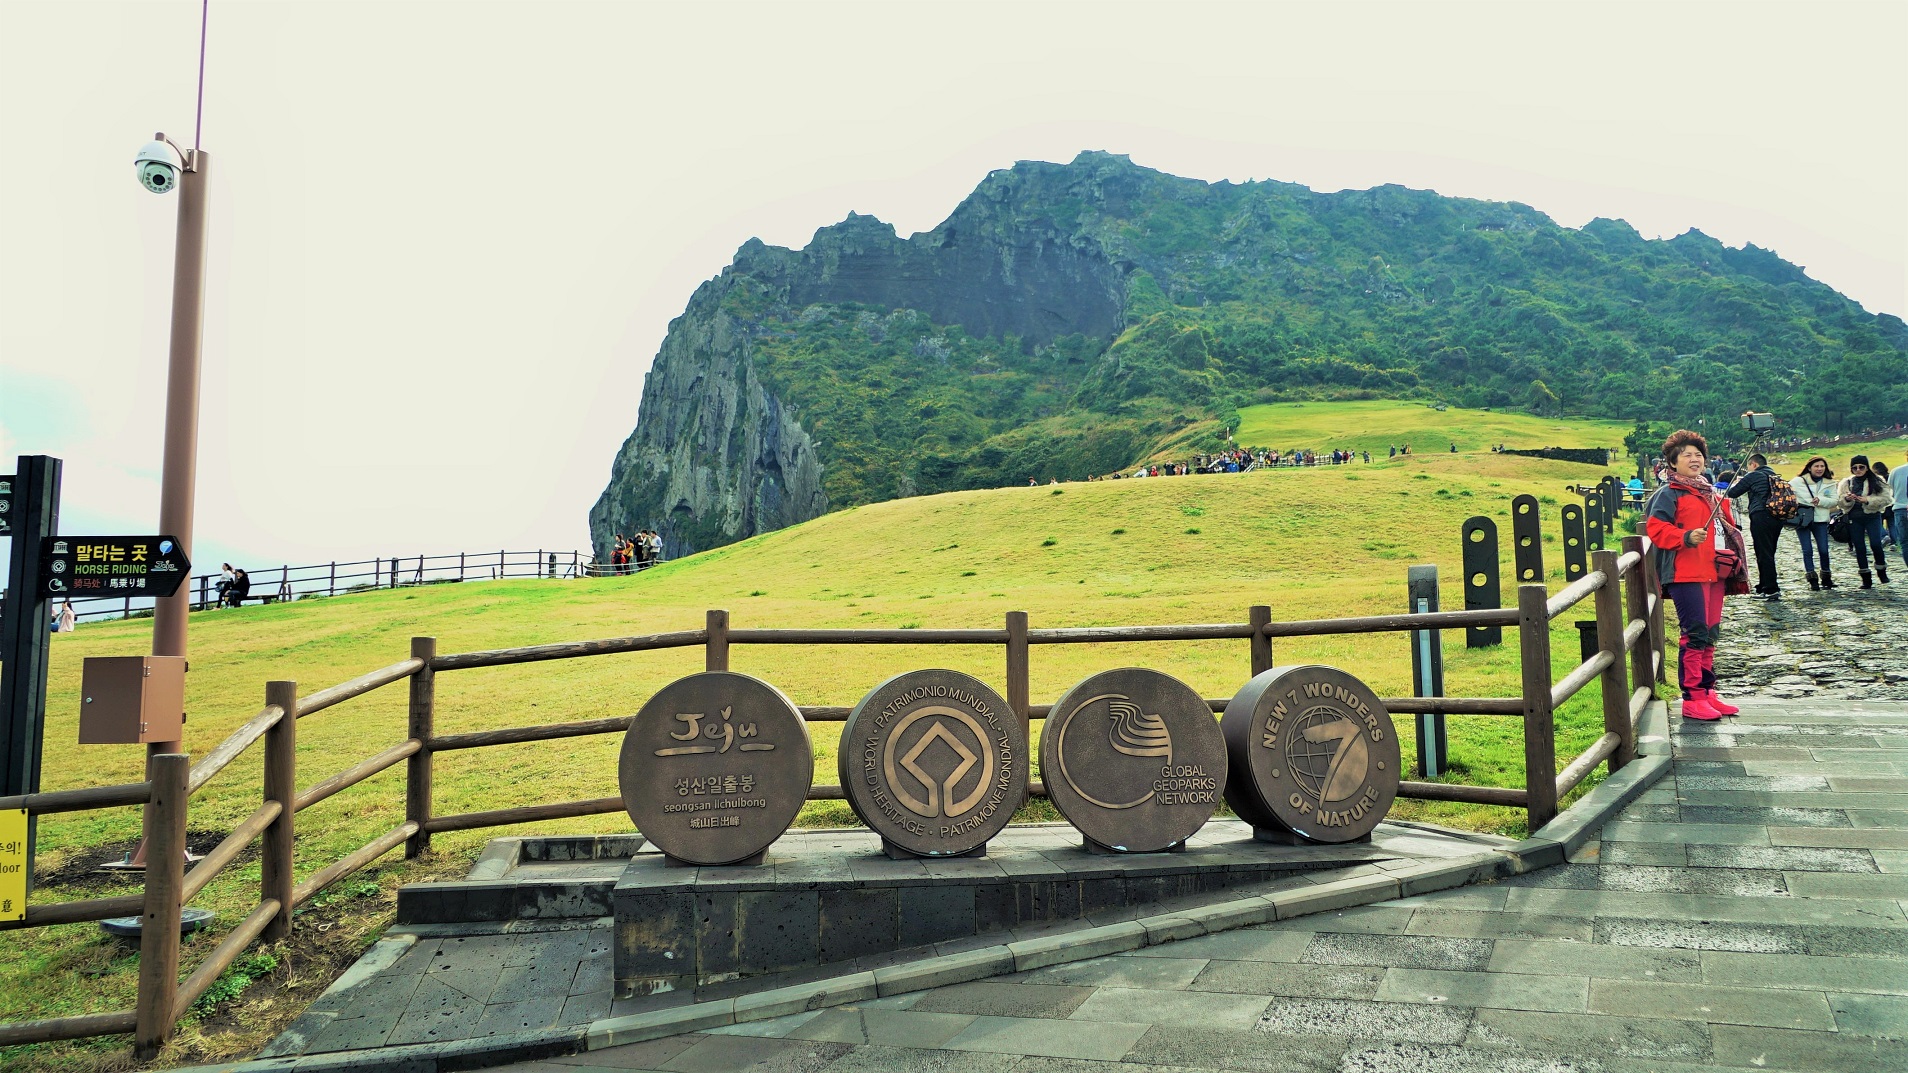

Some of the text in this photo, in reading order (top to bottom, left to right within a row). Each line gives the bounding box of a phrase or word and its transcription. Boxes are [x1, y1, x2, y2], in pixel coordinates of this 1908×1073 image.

[76, 544, 148, 561] 말타는 곳
[74, 564, 147, 574] HORSE RIDING
[73, 578, 101, 589] 骑马处
[875, 685, 1000, 730] PATRIMONIO MUNDIAL
[1262, 682, 1384, 750] NEW 7 WONDERS
[670, 705, 758, 754] Jeju
[1161, 765, 1206, 778] GLOBAL
[674, 774, 756, 796] 성산일출봉
[864, 736, 926, 836] WORLD HERITAGE
[940, 730, 1013, 838] PATRIMOINE MONDIAL
[1153, 777, 1217, 792] GEOPARKS
[1156, 791, 1216, 805] NETWORK
[1289, 785, 1381, 827] OF NATURE
[664, 802, 711, 813] seongsan
[690, 816, 740, 829] 城山日出峰
